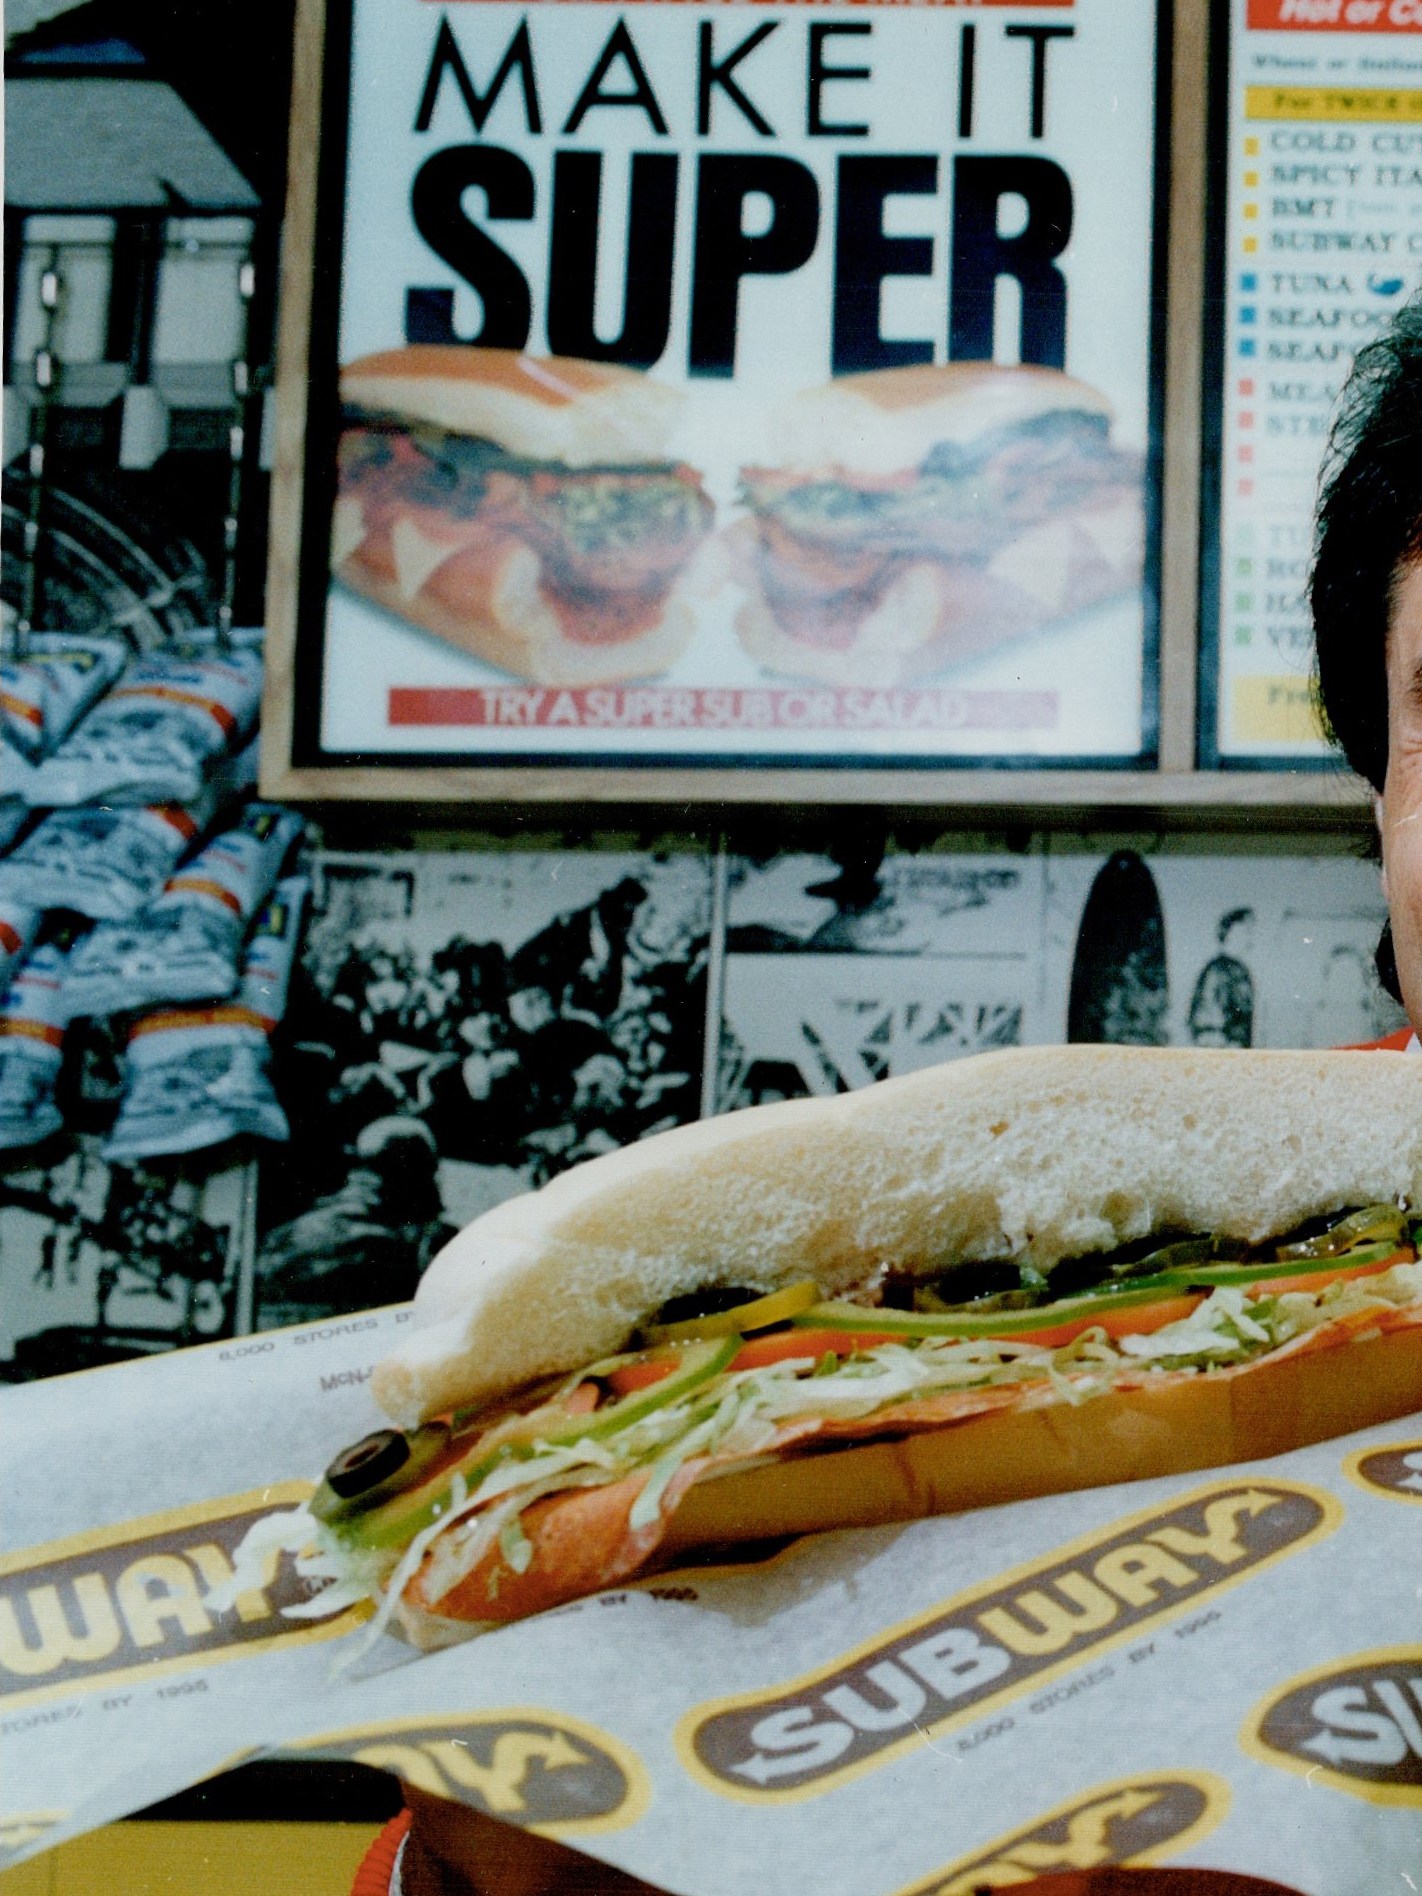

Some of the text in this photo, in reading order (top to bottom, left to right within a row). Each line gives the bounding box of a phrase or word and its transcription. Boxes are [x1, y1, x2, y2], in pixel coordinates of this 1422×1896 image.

[413, 16, 1075, 139] MAKE IT
[1270, 131, 1356, 153] COLD
[1270, 163, 1361, 187] SPICY
[1271, 197, 1335, 218] BMT
[1271, 230, 1397, 253] SUBWAY
[405, 142, 1076, 380] SUPER
[1270, 272, 1352, 296] TUNA
[1269, 307, 1396, 328] SEAFOO
[482, 687, 969, 730] TRY A SUPER SUB OR SALAD
[294, 1318, 379, 1345] STORES
[731, 1487, 1283, 1786] SUBWAY
[1029, 1664, 1116, 1714] STORES
[1128, 1642, 1155, 1664] BY
